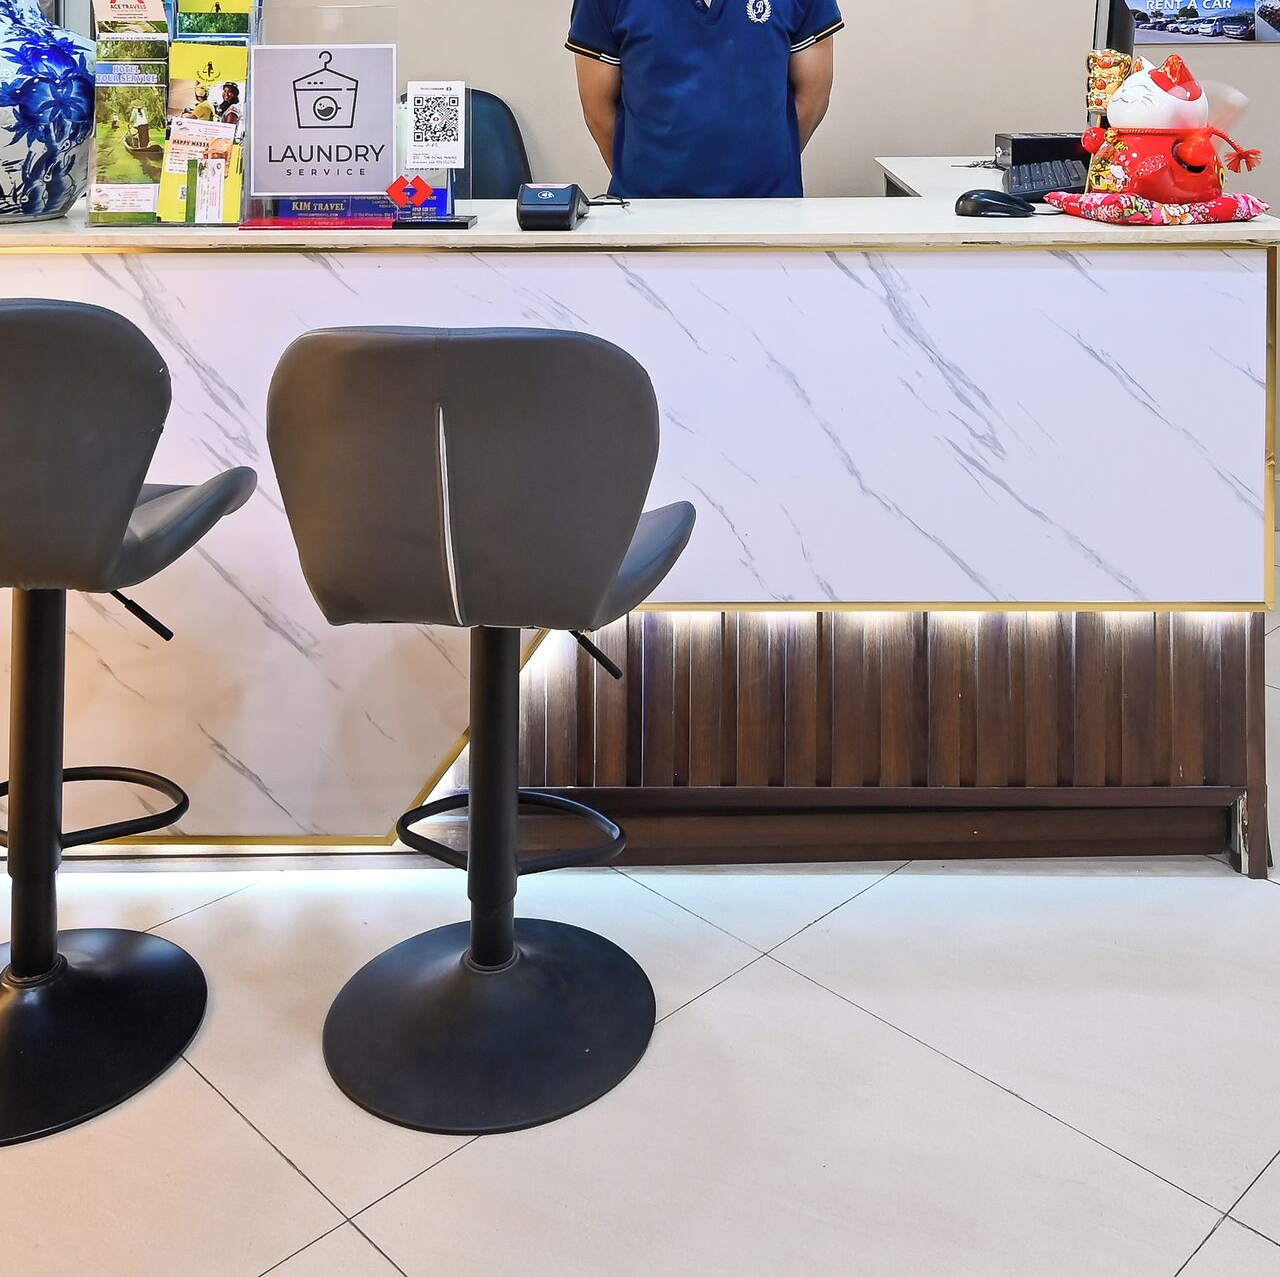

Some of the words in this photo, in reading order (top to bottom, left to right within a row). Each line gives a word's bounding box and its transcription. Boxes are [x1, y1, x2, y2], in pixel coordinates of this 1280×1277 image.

[1146, 0, 1183, 10] RENT
[1188, 0, 1198, 9] A
[1203, 0, 1232, 9] CAR
[113, 65, 140, 73] HOTEL
[97, 74, 119, 82] TOUR
[121, 74, 157, 82] SERVICE
[268, 144, 385, 163] LAUNDRY
[286, 168, 365, 176] SERVICE
[292, 202, 311, 211] KIM
[314, 202, 345, 210] TRAVEL
